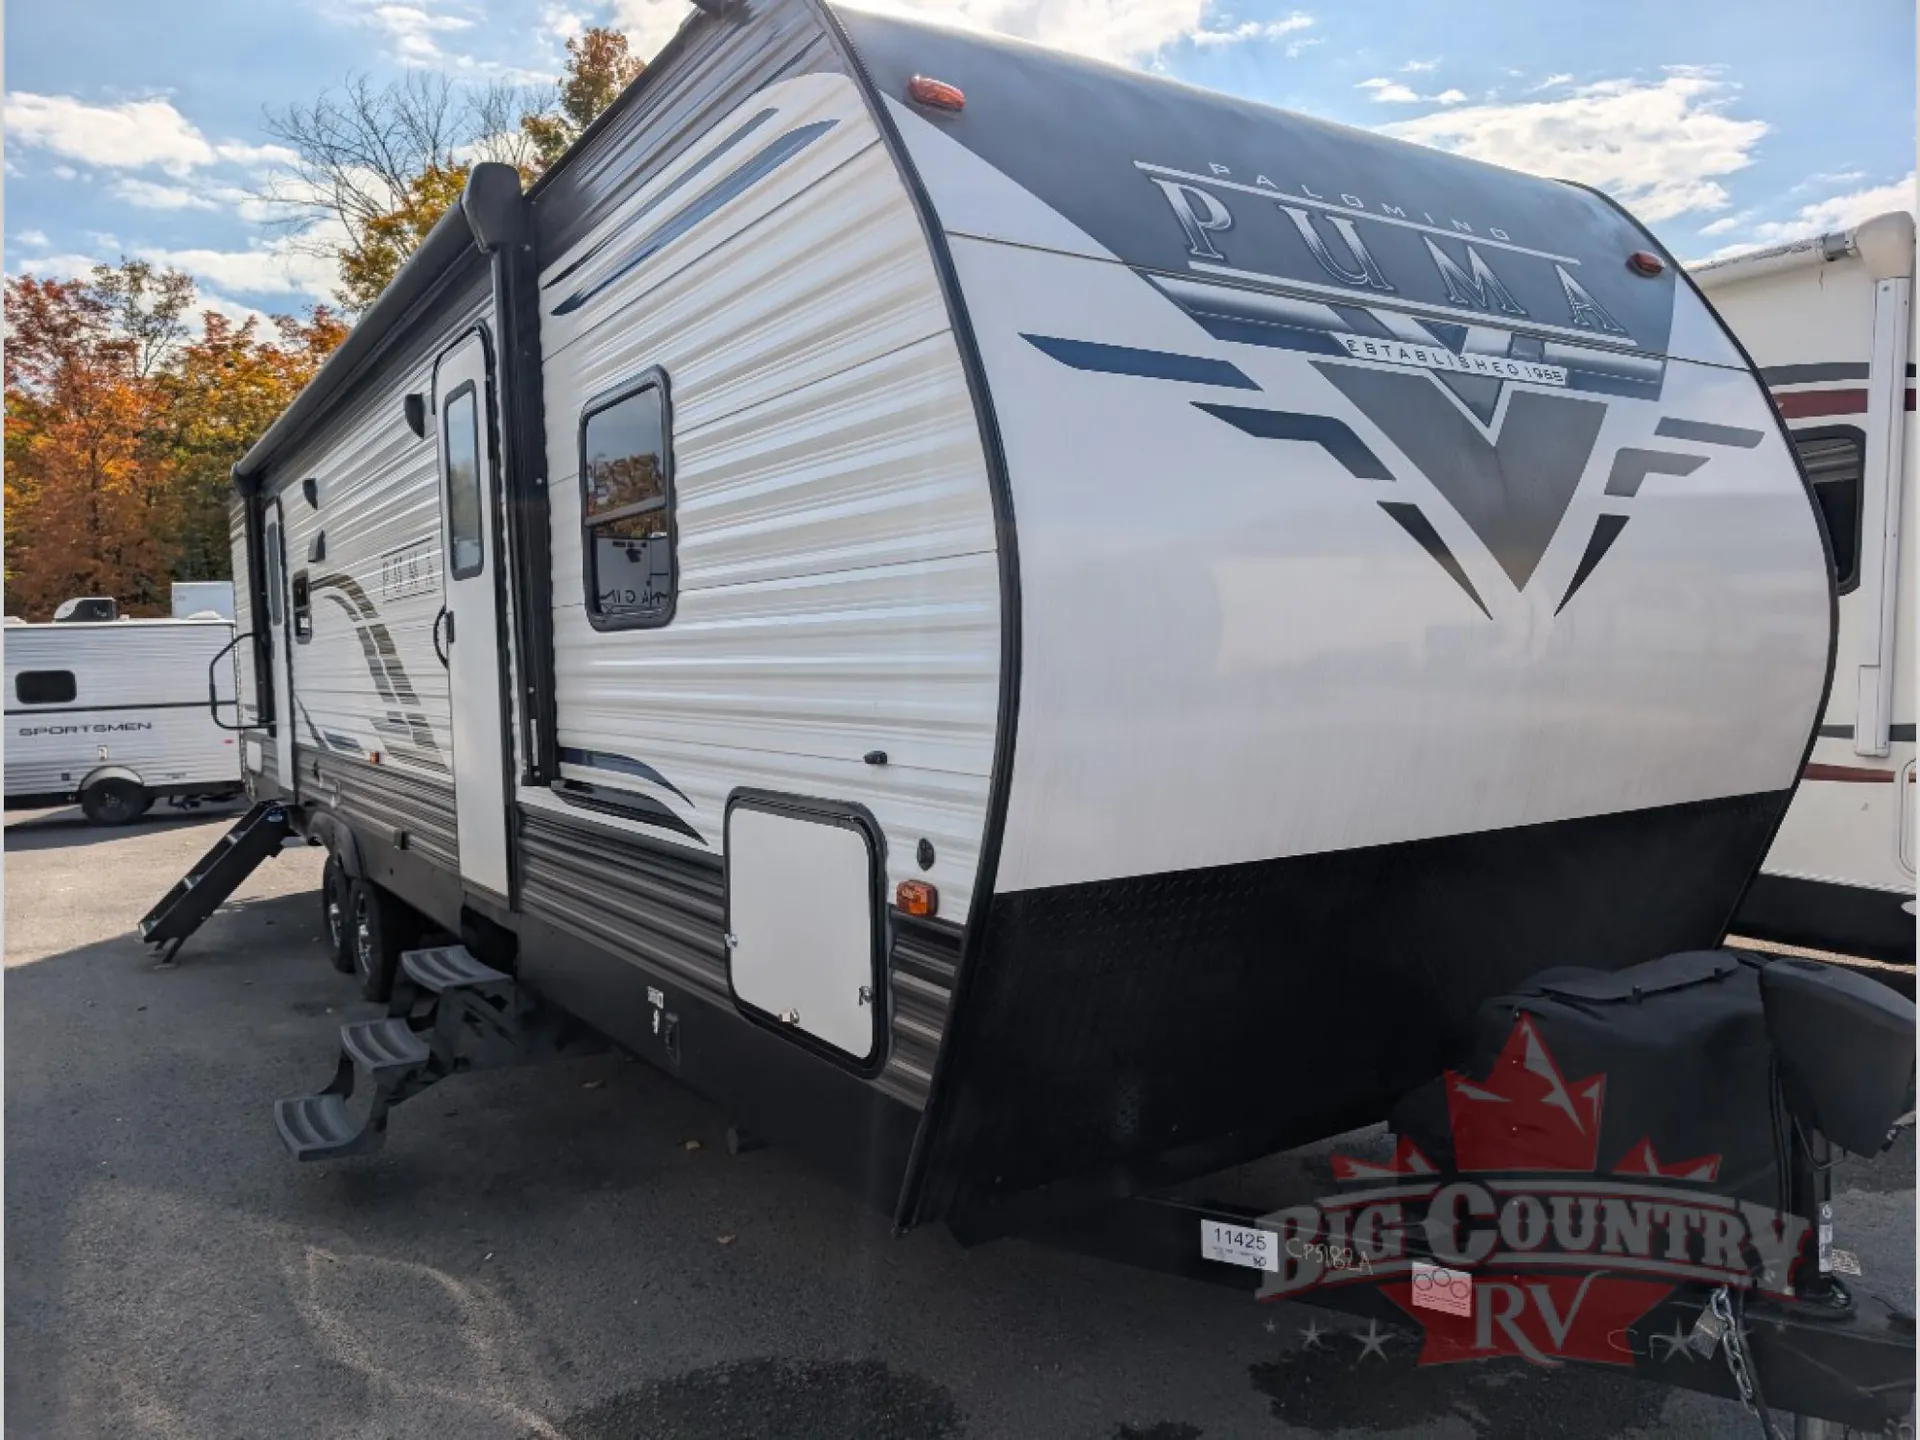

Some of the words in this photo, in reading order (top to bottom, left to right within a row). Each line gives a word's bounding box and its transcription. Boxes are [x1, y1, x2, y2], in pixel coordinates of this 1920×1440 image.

[1208, 161, 1511, 241] PALOMINO
[1152, 176, 1628, 334] PUMA
[1345, 338, 1520, 377] ESTABLISHED
[18, 722, 152, 737] SPORTSMEN
[1214, 1227, 1267, 1251] 11425
